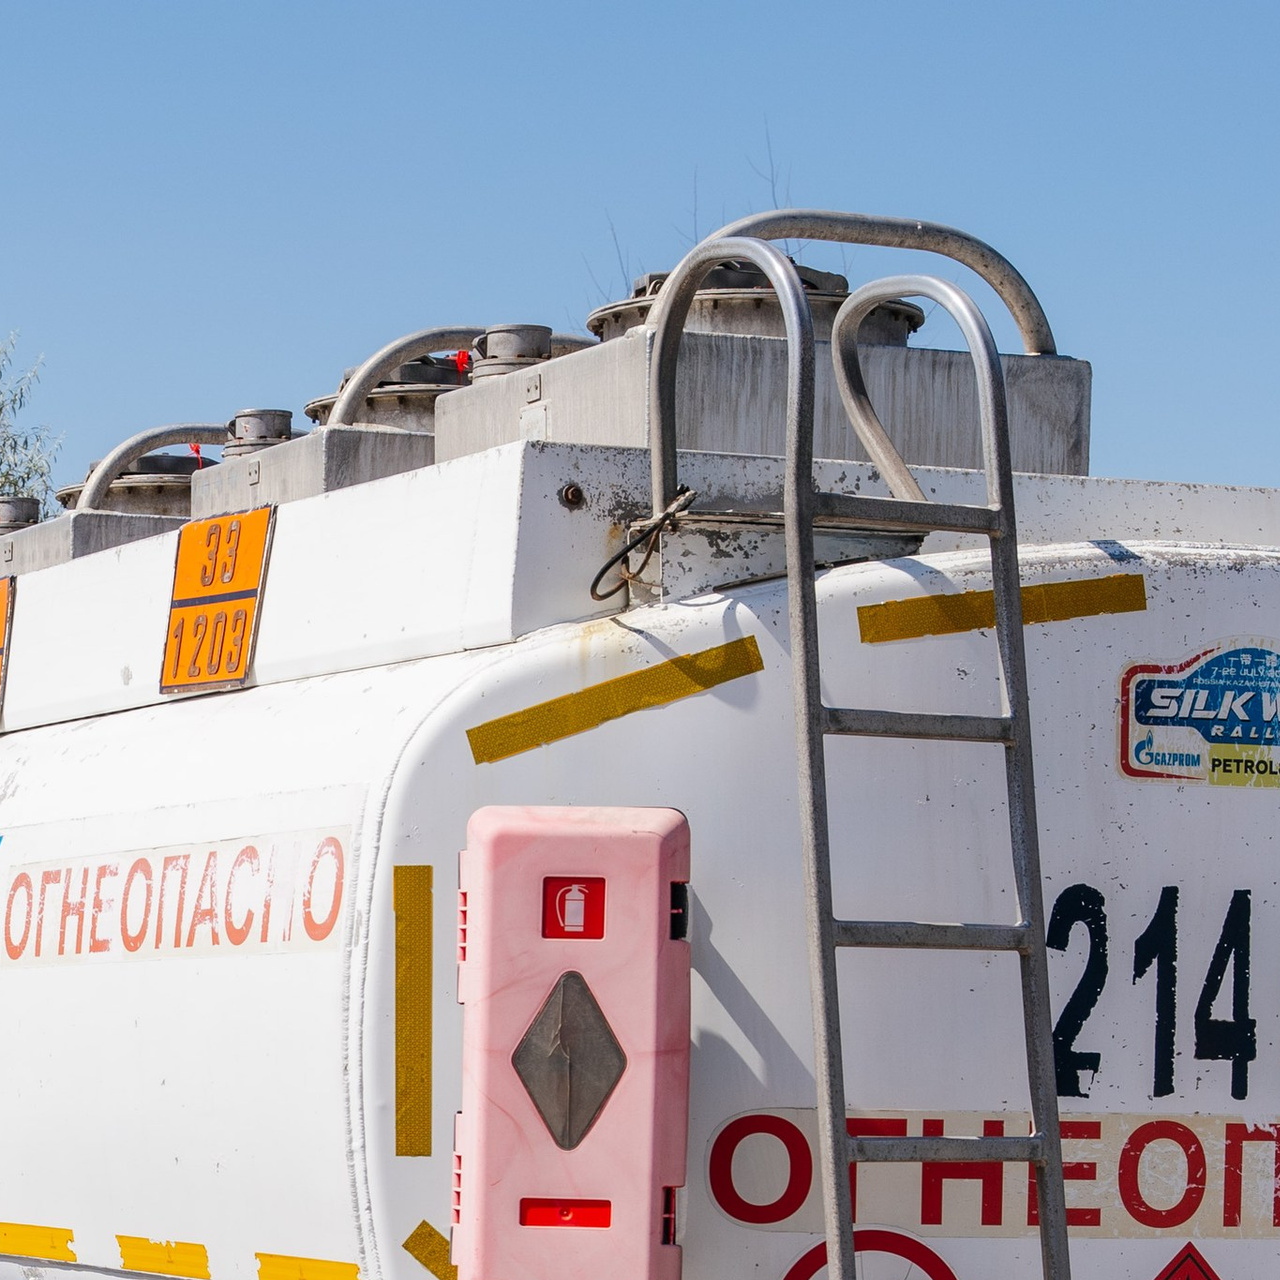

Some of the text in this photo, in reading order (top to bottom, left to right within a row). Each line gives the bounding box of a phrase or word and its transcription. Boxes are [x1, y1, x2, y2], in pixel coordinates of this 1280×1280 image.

[201, 519, 241, 588] 33
[171, 608, 248, 680] 1203
[1146, 687, 1256, 721] SILK
[1154, 751, 1200, 768] GAZPROM
[1211, 757, 1280, 776] PETROL
[4, 836, 345, 960] ОГНЕОПАСО
[1045, 883, 1257, 1100] 214
[709, 1113, 1280, 1229] ОНЕОП
